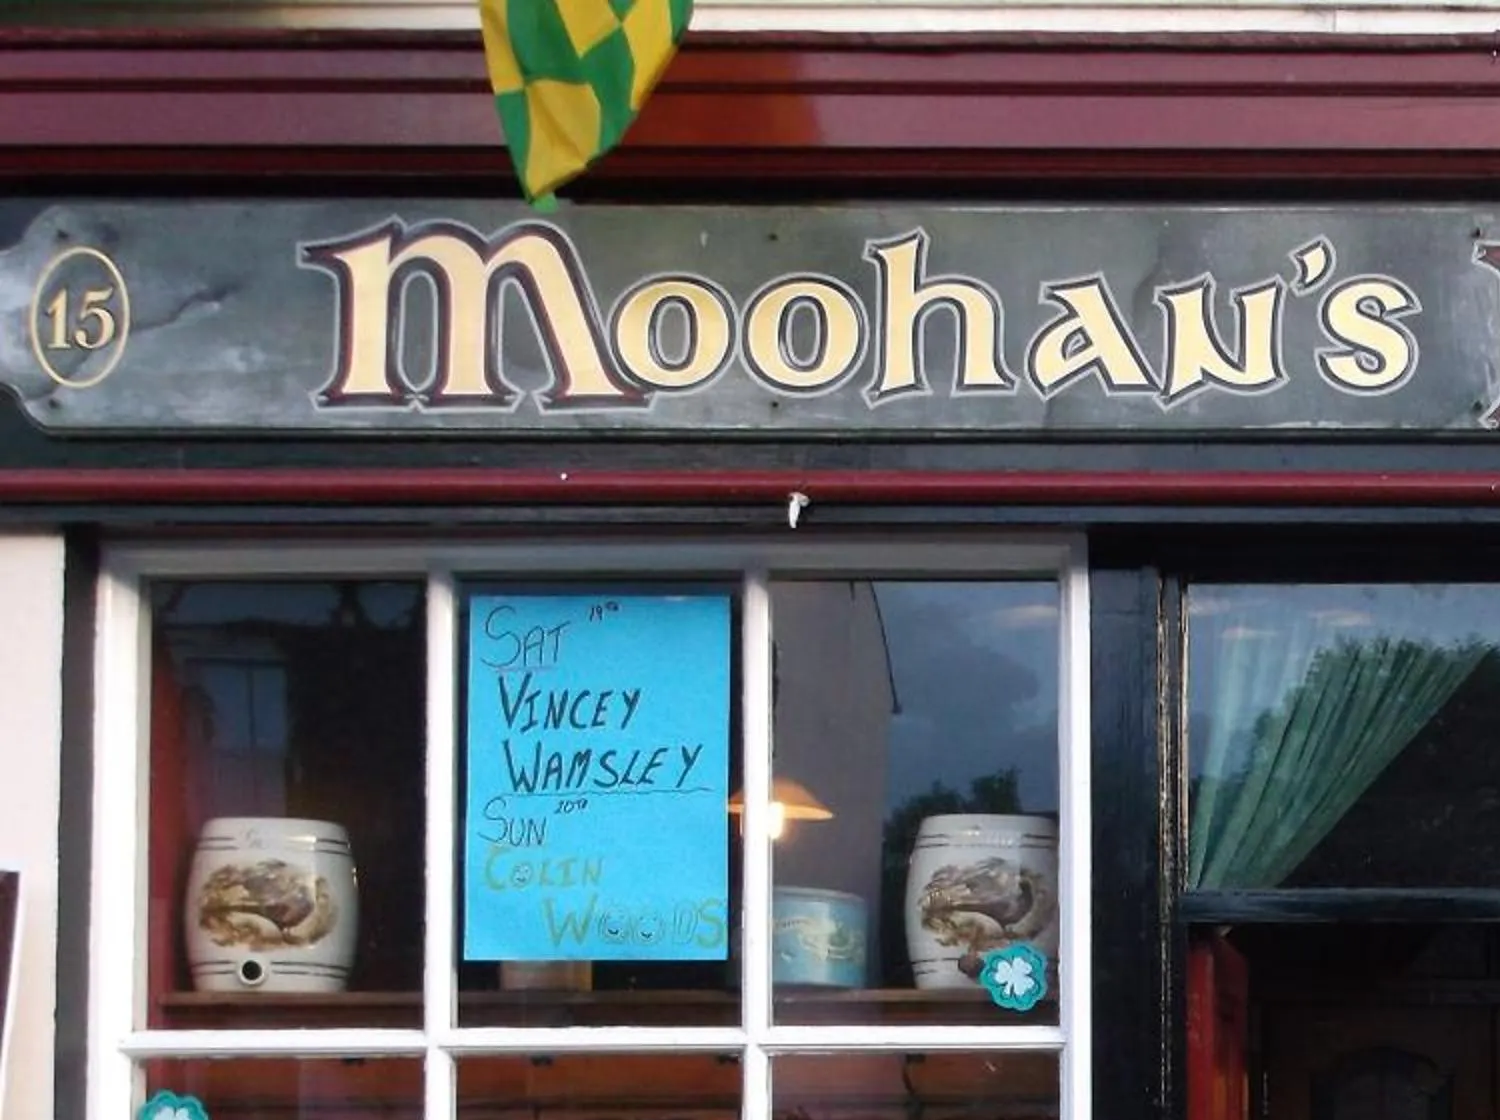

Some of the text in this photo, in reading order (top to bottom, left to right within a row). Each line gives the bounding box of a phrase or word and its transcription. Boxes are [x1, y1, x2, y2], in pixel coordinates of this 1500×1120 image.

[45, 284, 116, 352] 15
[299, 214, 1422, 413] Moohan's
[480, 604, 571, 668] SAT
[498, 673, 642, 732] VINCEY
[502, 740, 704, 793] WAMSLEY
[477, 797, 546, 847] SUN
[483, 846, 603, 891] COLIN
